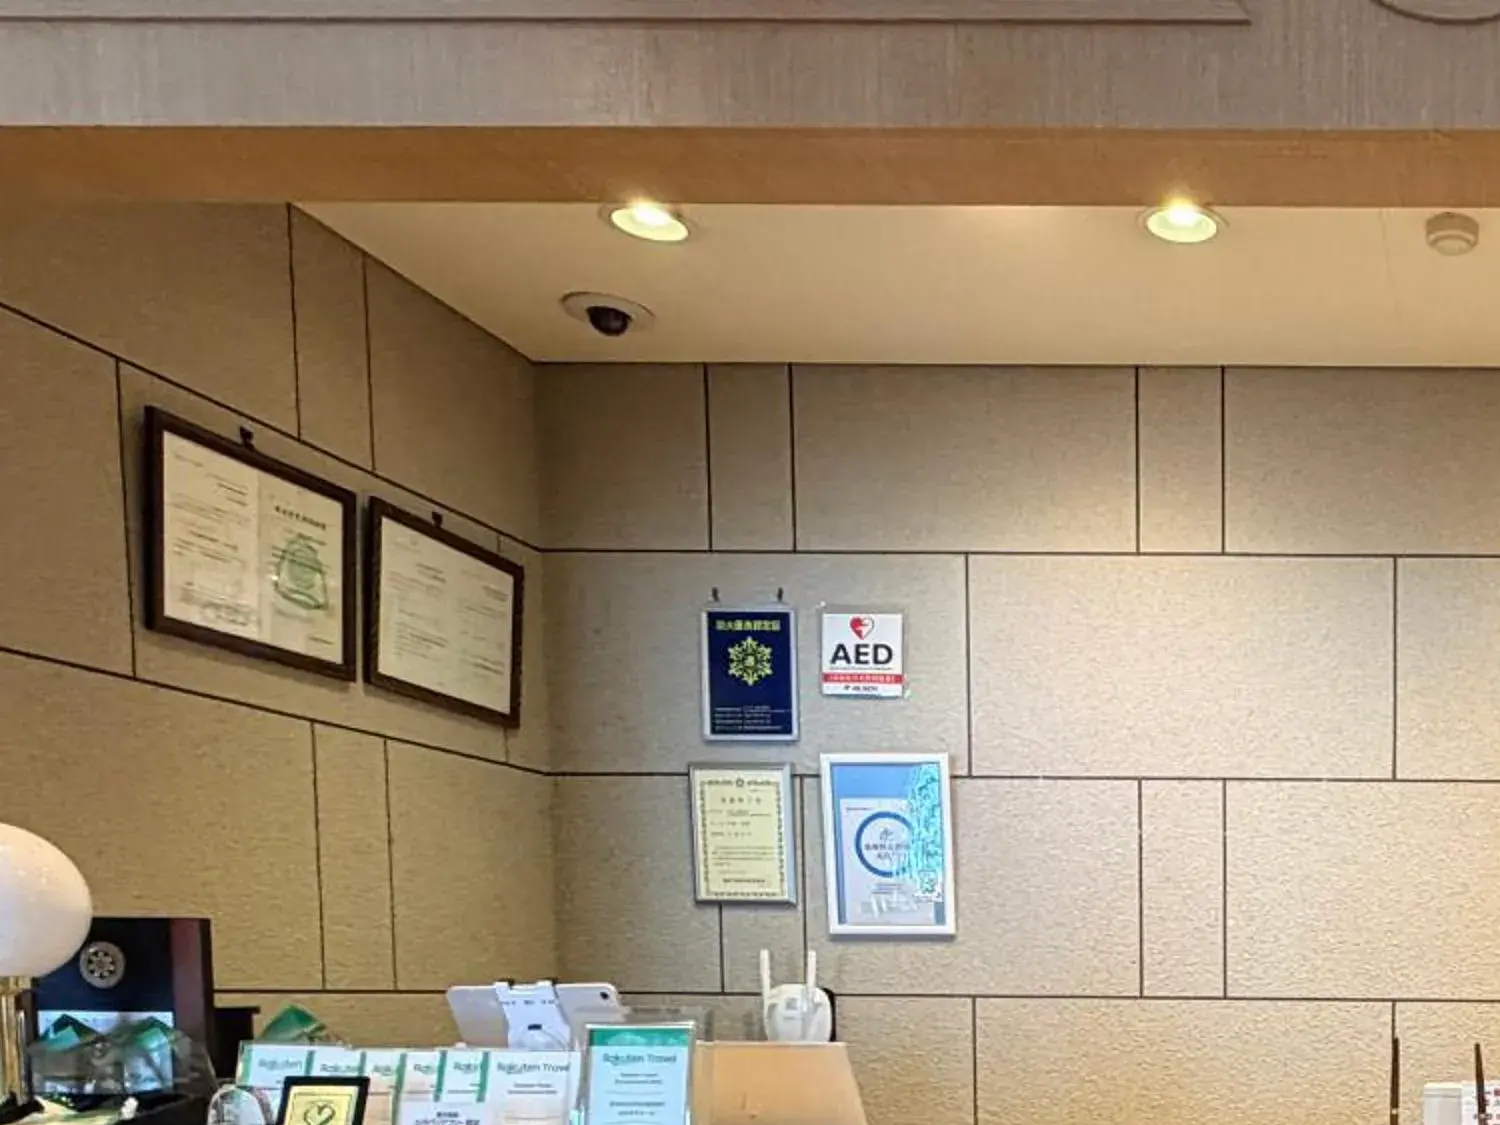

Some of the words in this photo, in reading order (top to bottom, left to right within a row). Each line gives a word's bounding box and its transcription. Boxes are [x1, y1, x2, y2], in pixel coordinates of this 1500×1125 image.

[830, 643, 893, 665] AED
[603, 1053, 644, 1065] Rakuten
[497, 1062, 540, 1075] Rakuten
